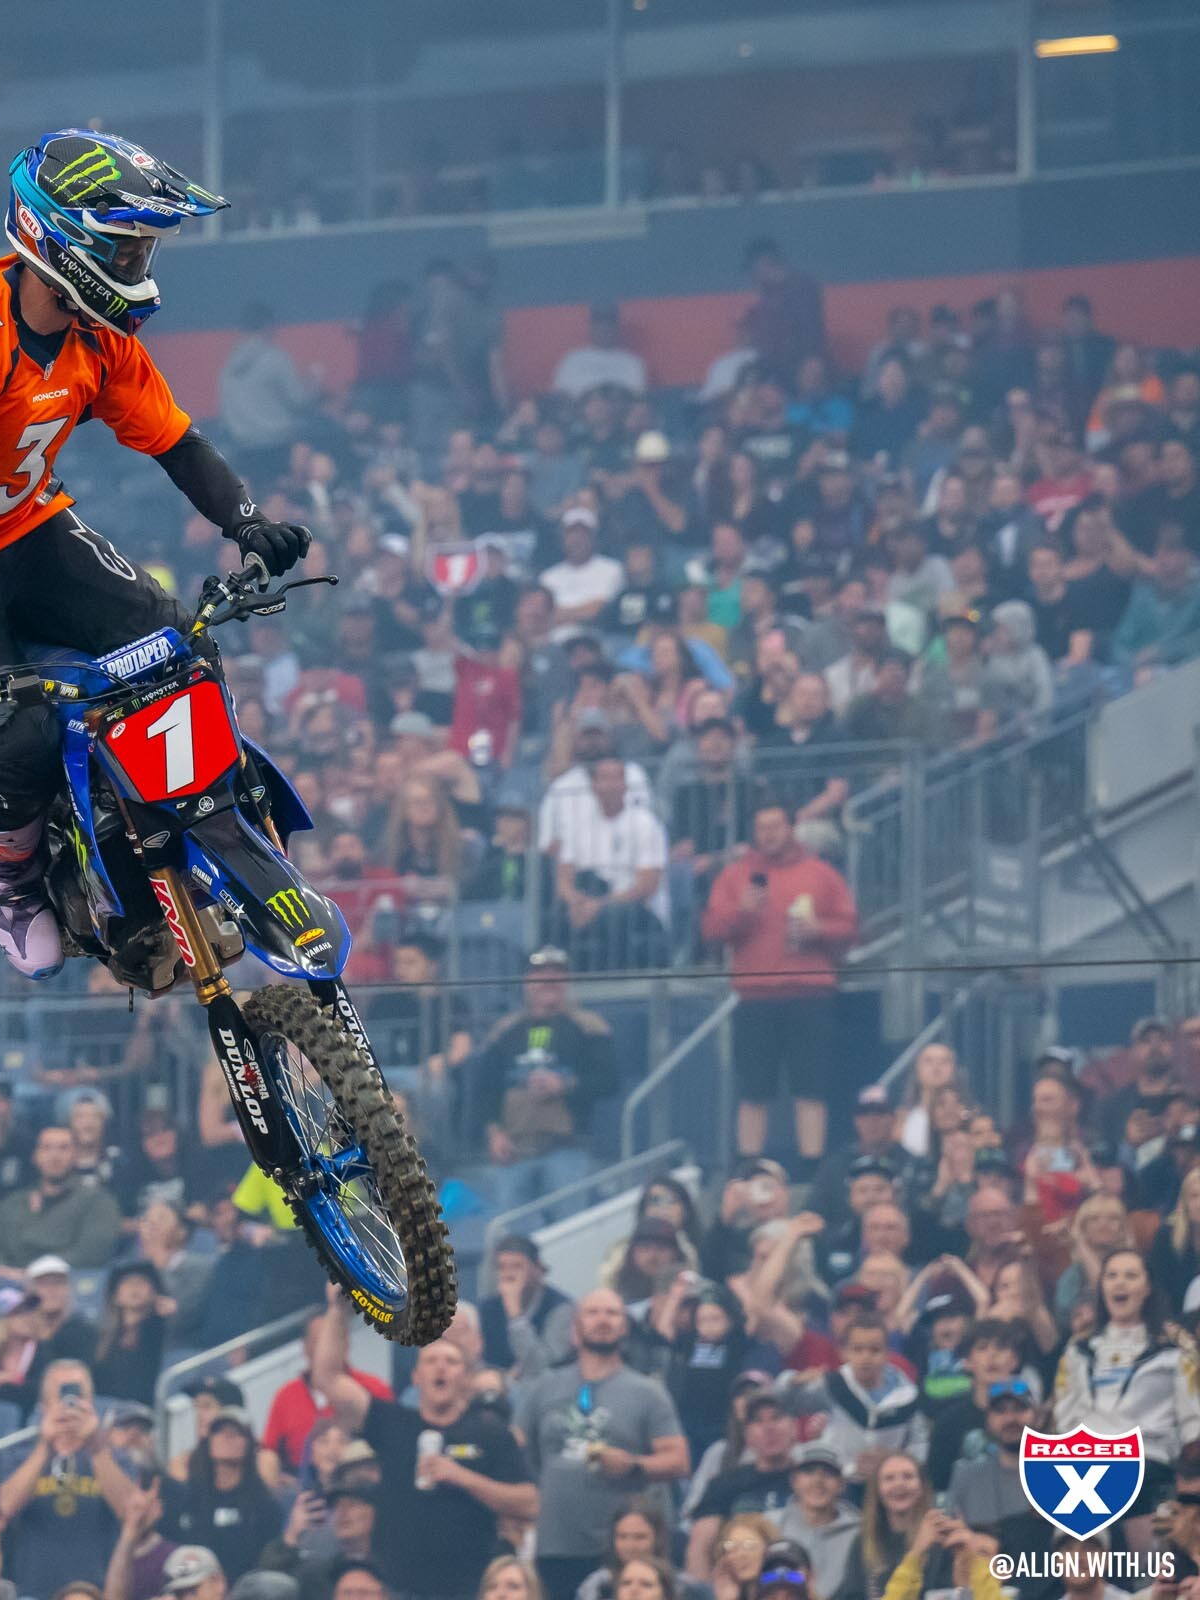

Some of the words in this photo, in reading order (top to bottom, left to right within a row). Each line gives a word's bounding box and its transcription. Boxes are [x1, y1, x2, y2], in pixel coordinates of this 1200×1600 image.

[20, 210, 39, 237] BELL
[58, 251, 112, 301] MONSTER
[106, 637, 172, 678] PROTAPER
[141, 681, 179, 703] MONSTER
[146, 692, 195, 795] 1
[198, 868, 213, 886] YAMAHA
[305, 941, 333, 959] YAMAHA
[218, 1028, 269, 1135] DUNLOP
[351, 1289, 393, 1323] DUNLOP
